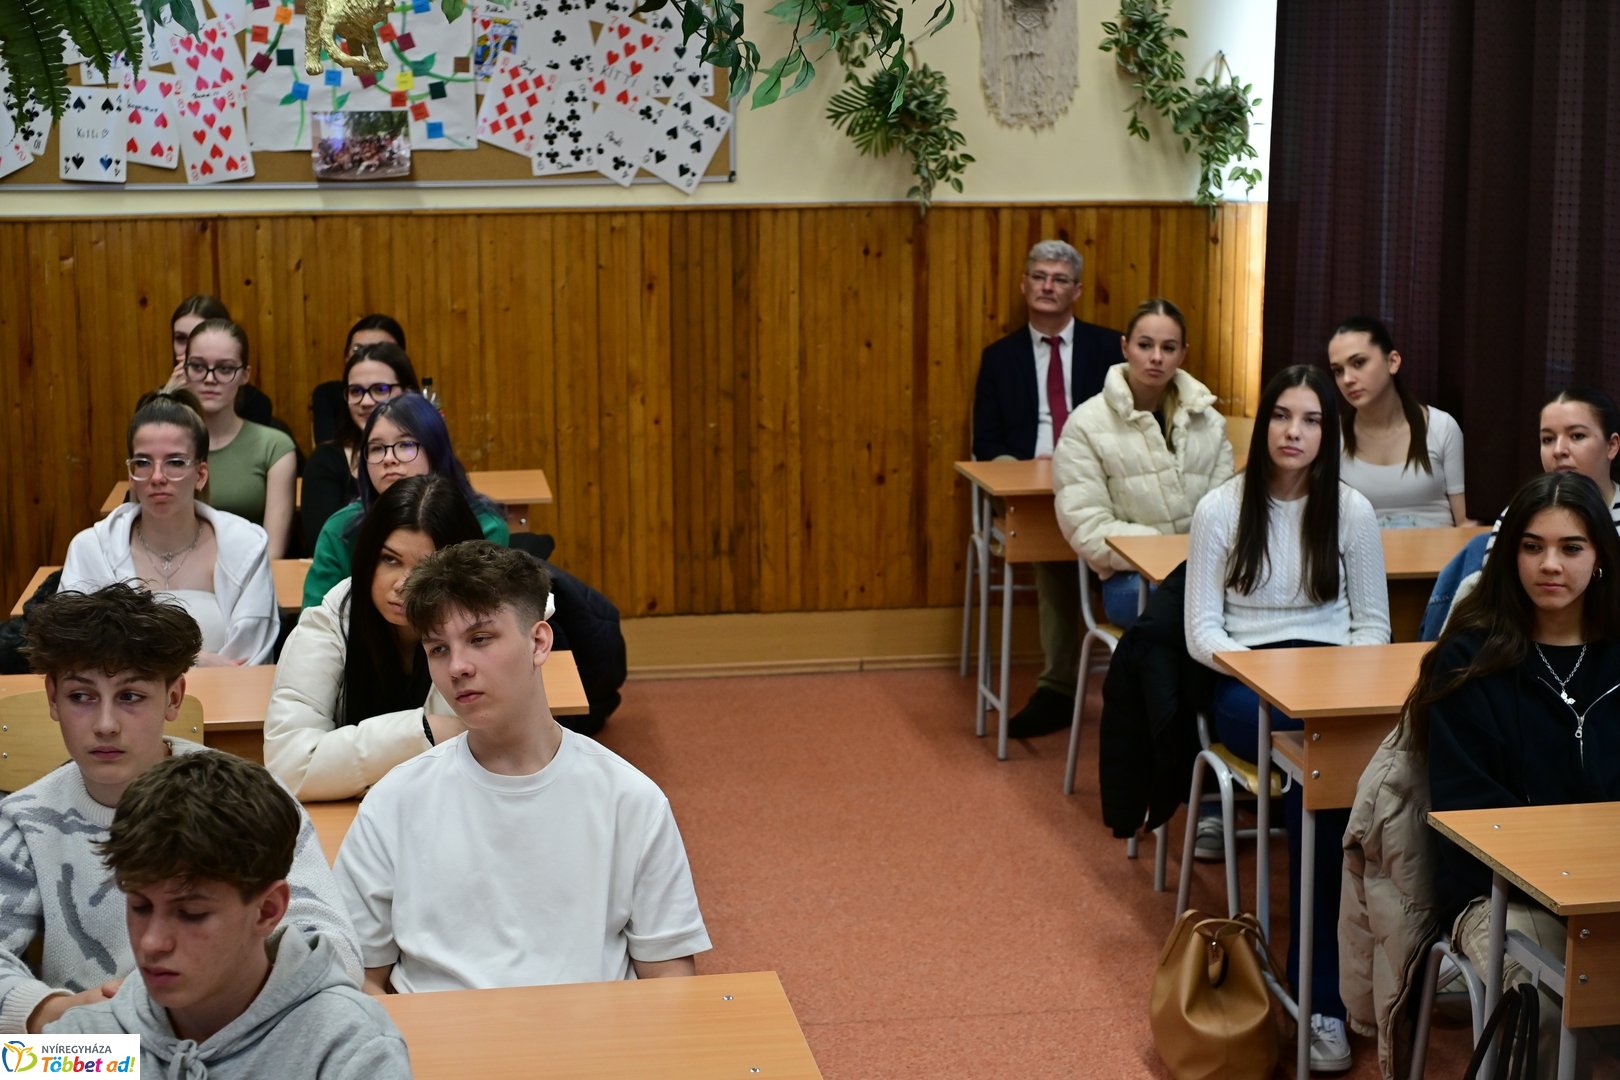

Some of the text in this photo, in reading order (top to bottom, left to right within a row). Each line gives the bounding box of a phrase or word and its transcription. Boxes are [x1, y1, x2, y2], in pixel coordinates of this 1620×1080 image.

[611, 16, 619, 25] 7
[657, 36, 665, 44] 7
[600, 65, 638, 88] KITTI
[116, 94, 122, 104] 4
